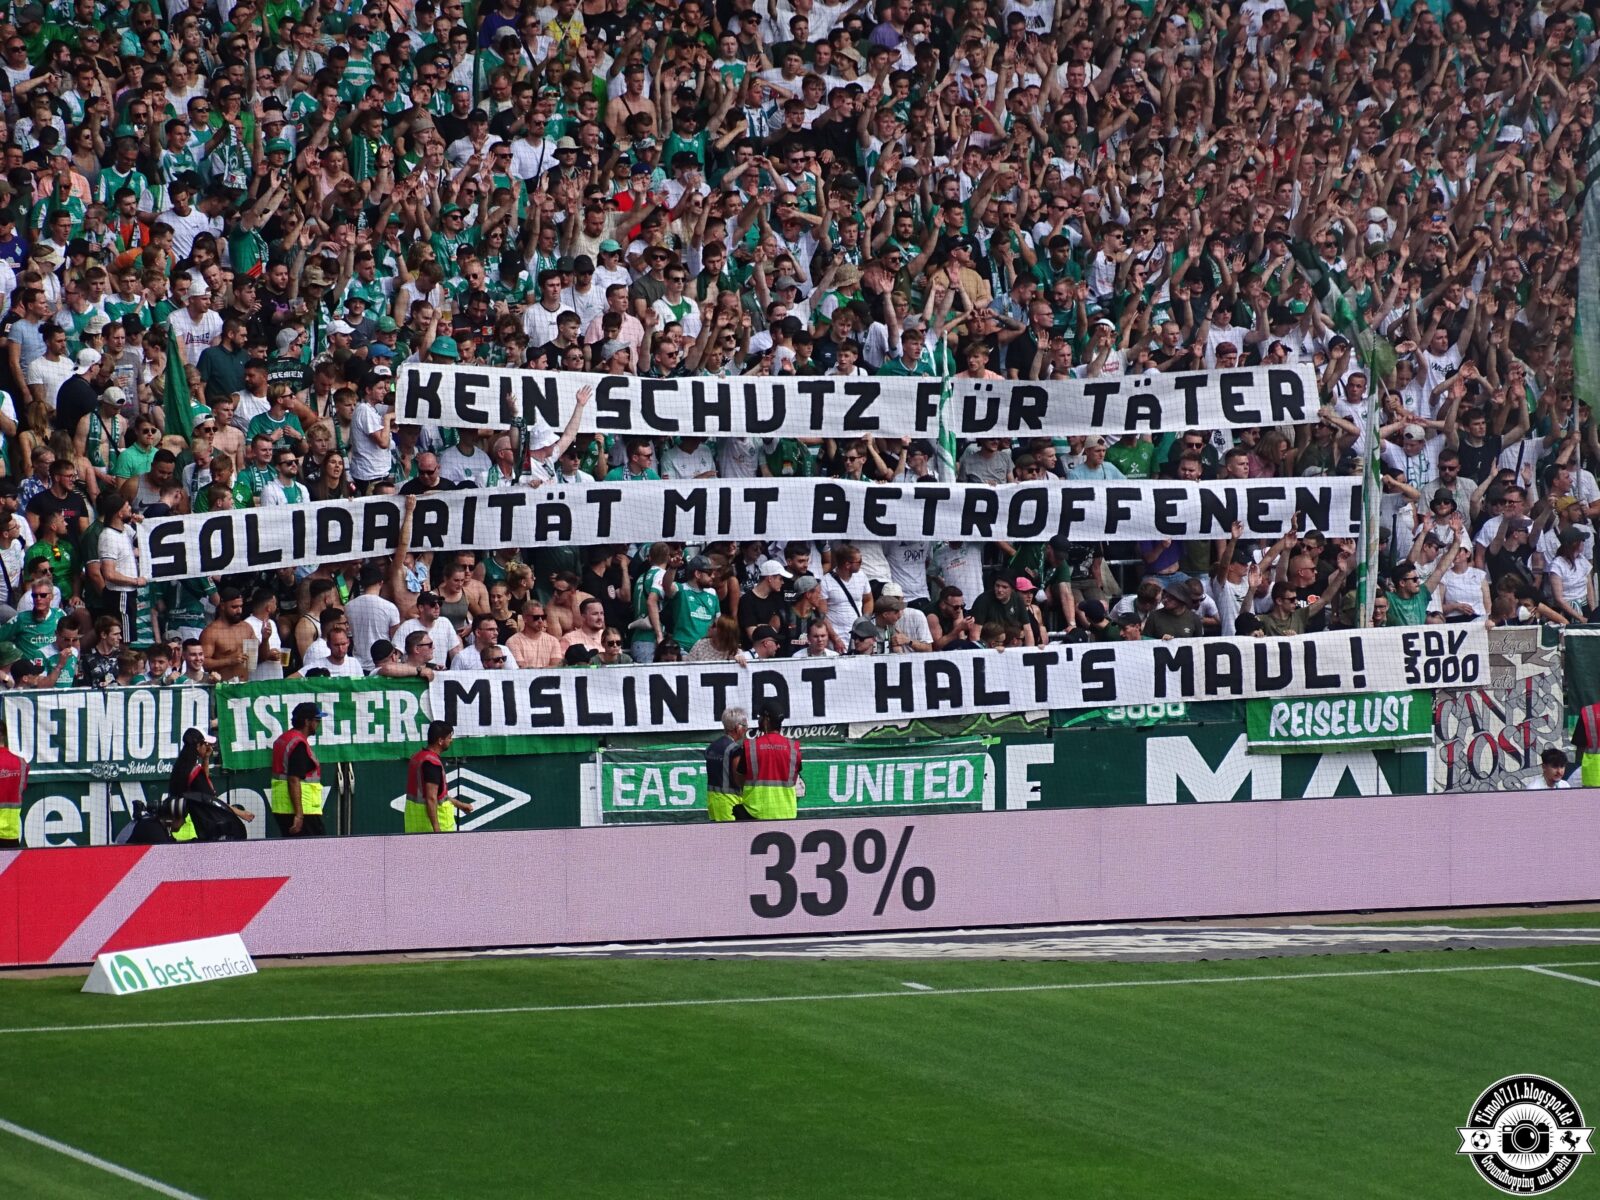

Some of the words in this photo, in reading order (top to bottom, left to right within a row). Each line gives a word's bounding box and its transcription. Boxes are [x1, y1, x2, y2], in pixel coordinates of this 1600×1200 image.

[404, 369, 559, 427] KEIN
[596, 376, 880, 433] SCHUTZ
[914, 381, 1048, 432] FÜR
[1083, 368, 1305, 431] TÄTER
[150, 488, 621, 578] SOLIDARITÄT
[662, 487, 779, 537] MIT
[812, 482, 1362, 539] BETROFFENEN!
[1402, 630, 1468, 657] EDV
[1403, 653, 1479, 684] 3000
[443, 666, 836, 728] MISLINTAT
[874, 647, 1117, 713] HALT'S
[1153, 636, 1366, 698] MAUL!
[4, 689, 210, 763] DETMOLD
[1269, 695, 1413, 738] REISELUST
[828, 756, 975, 806] UNITED
[750, 826, 936, 919] 33%
[146, 956, 203, 986] best
[202, 954, 254, 980] medical
